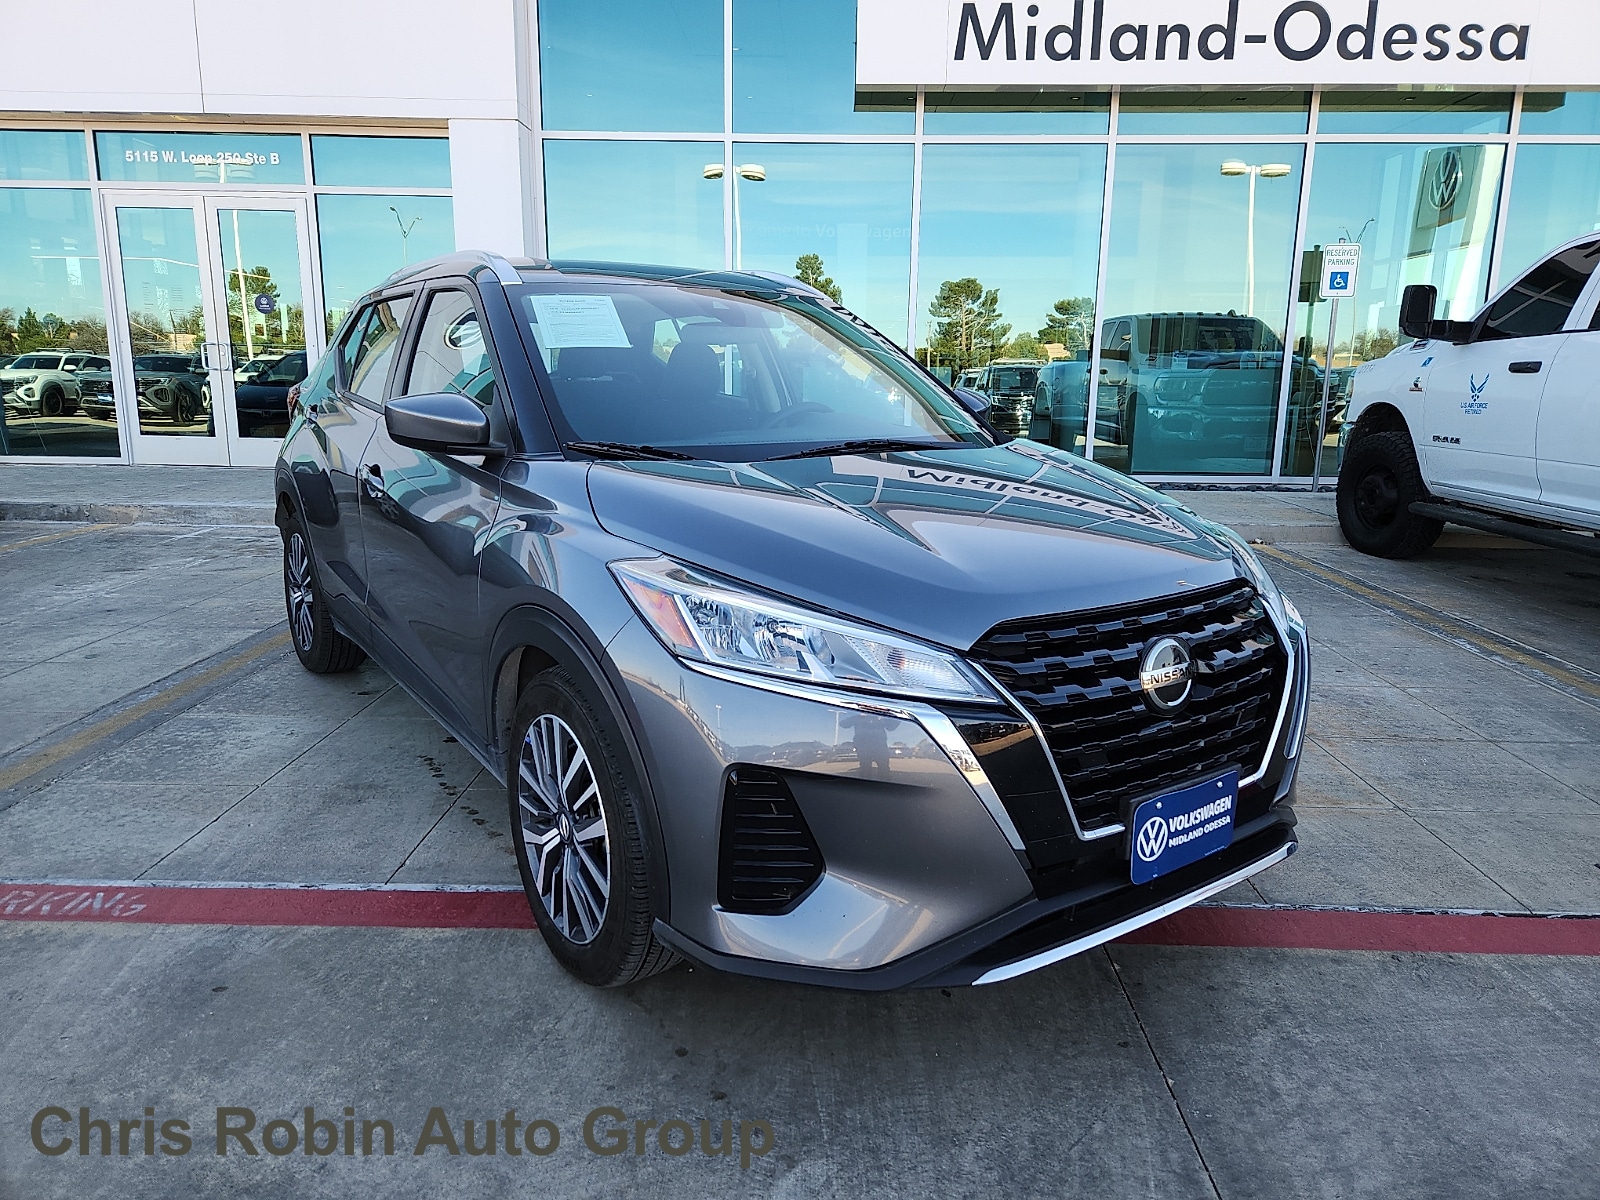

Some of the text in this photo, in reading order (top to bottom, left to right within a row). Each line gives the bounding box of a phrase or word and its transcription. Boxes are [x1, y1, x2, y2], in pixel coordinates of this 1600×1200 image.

[953, 0, 1531, 61] Midland-Odessa
[125, 151, 280, 166] 5115 W. Loop 250 Ste B
[1326, 248, 1358, 258] RESERVED
[1327, 258, 1355, 266] PARKING
[1149, 665, 1191, 685] NISSAN
[1168, 795, 1232, 833] VOLKSWAGEN
[1168, 815, 1231, 848] MIDLAND ODESSA
